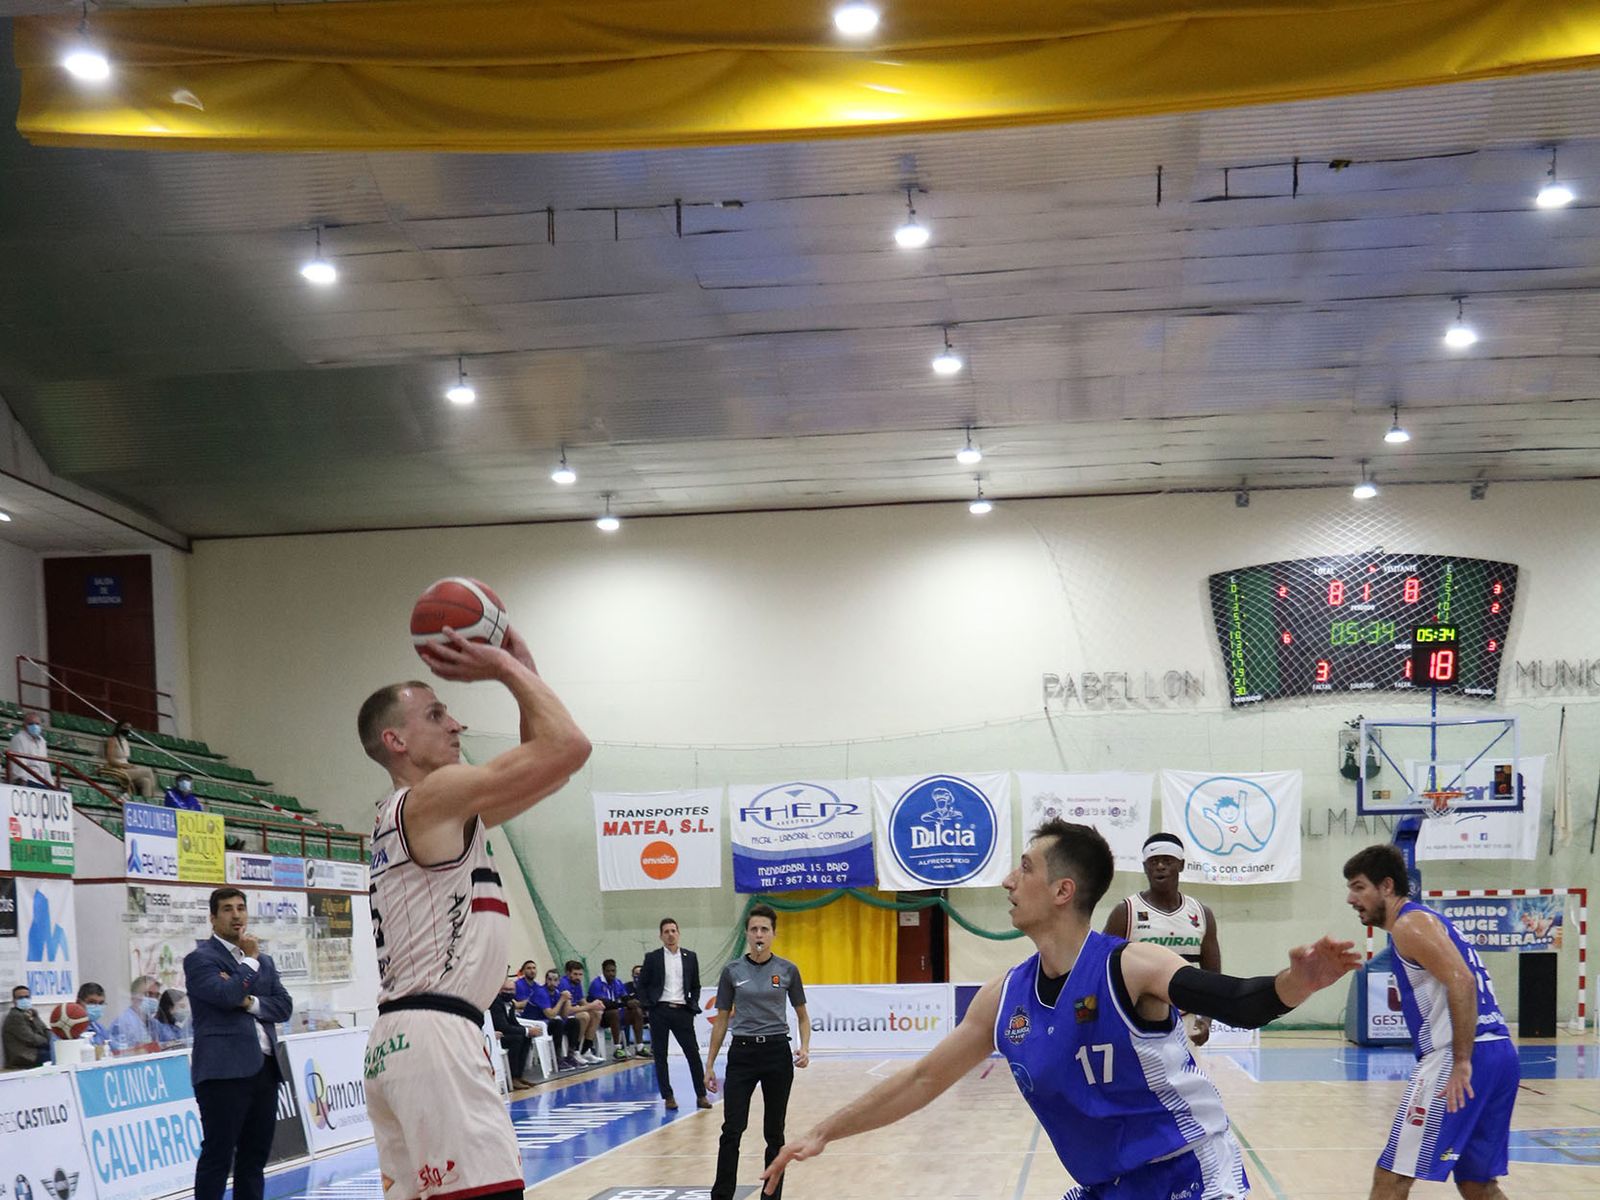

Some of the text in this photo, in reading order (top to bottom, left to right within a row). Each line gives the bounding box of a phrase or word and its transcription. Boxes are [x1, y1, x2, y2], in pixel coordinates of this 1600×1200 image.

[1328, 580, 1344, 606] 8
[1404, 578, 1420, 604] 8
[1493, 582, 1502, 595] 3
[1491, 602, 1501, 614] 2
[1331, 621, 1395, 645] 05:34
[1416, 628, 1455, 642] 05:34
[1487, 641, 1498, 652] 3
[1315, 661, 1329, 682] 3
[1429, 650, 1454, 680] 18
[1042, 670, 1206, 709] PABELLON
[127, 809, 176, 832] GASOLINERA
[609, 806, 709, 818] TRANSPORTES
[180, 814, 221, 836] POLLOS
[603, 819, 714, 836] MATEA, S.L.
[910, 823, 976, 849] Dulcia
[758, 863, 806, 876] MENDIZABAL
[826, 862, 849, 871] BAJO
[1220, 864, 1238, 874] con
[786, 875, 802, 885] 967
[806, 875, 817, 883] 34
[821, 874, 833, 883] 02
[836, 874, 847, 882] 67
[1444, 906, 1507, 918] CUANDO
[889, 1004, 941, 1012] viajes
[811, 1012, 939, 1032] almantour
[1075, 1043, 1113, 1085] 17
[103, 1063, 169, 1110] CLINICA
[91, 1110, 202, 1184] CALVARRO
